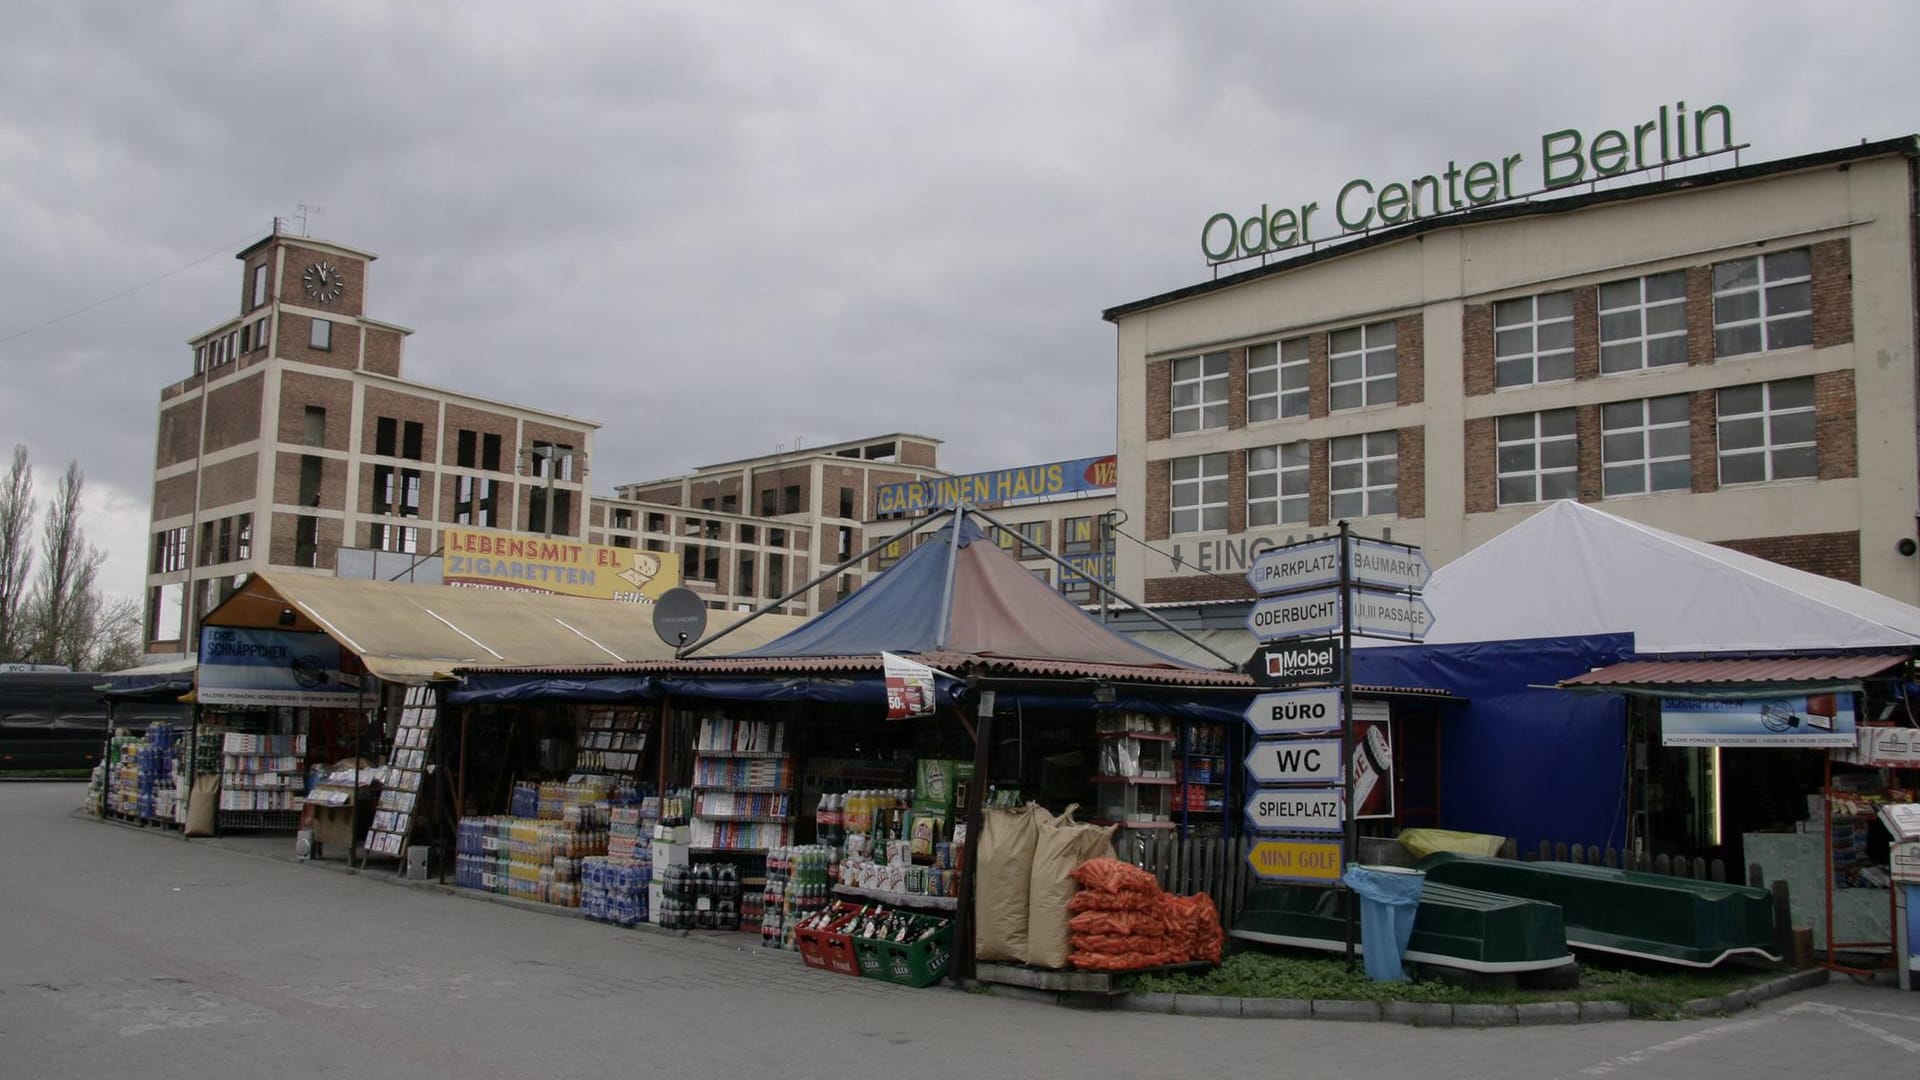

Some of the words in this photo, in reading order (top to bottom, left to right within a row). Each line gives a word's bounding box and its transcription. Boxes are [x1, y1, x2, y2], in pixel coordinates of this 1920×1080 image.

[1201, 203, 1318, 263] Oder
[1335, 153, 1521, 232] Center
[1541, 100, 1733, 188] Berlin
[880, 478, 990, 510] GARDINEN
[997, 464, 1064, 497] HAUS
[448, 555, 596, 586] ZIGARETTEN
[1060, 556, 1116, 580] LEIN
[1265, 555, 1336, 581] PARKPLATZ
[1354, 553, 1422, 577] BAUMARKT
[1254, 601, 1335, 627] ODERBUCHT
[1378, 606, 1425, 625] PASSAGE
[1284, 647, 1333, 668] Mobel
[1271, 702, 1326, 721] BÜRO
[1277, 749, 1322, 773] WC
[1258, 801, 1337, 818] SPIELPLATZ
[1259, 848, 1292, 867] MINI
[1298, 851, 1337, 870] GOLF
